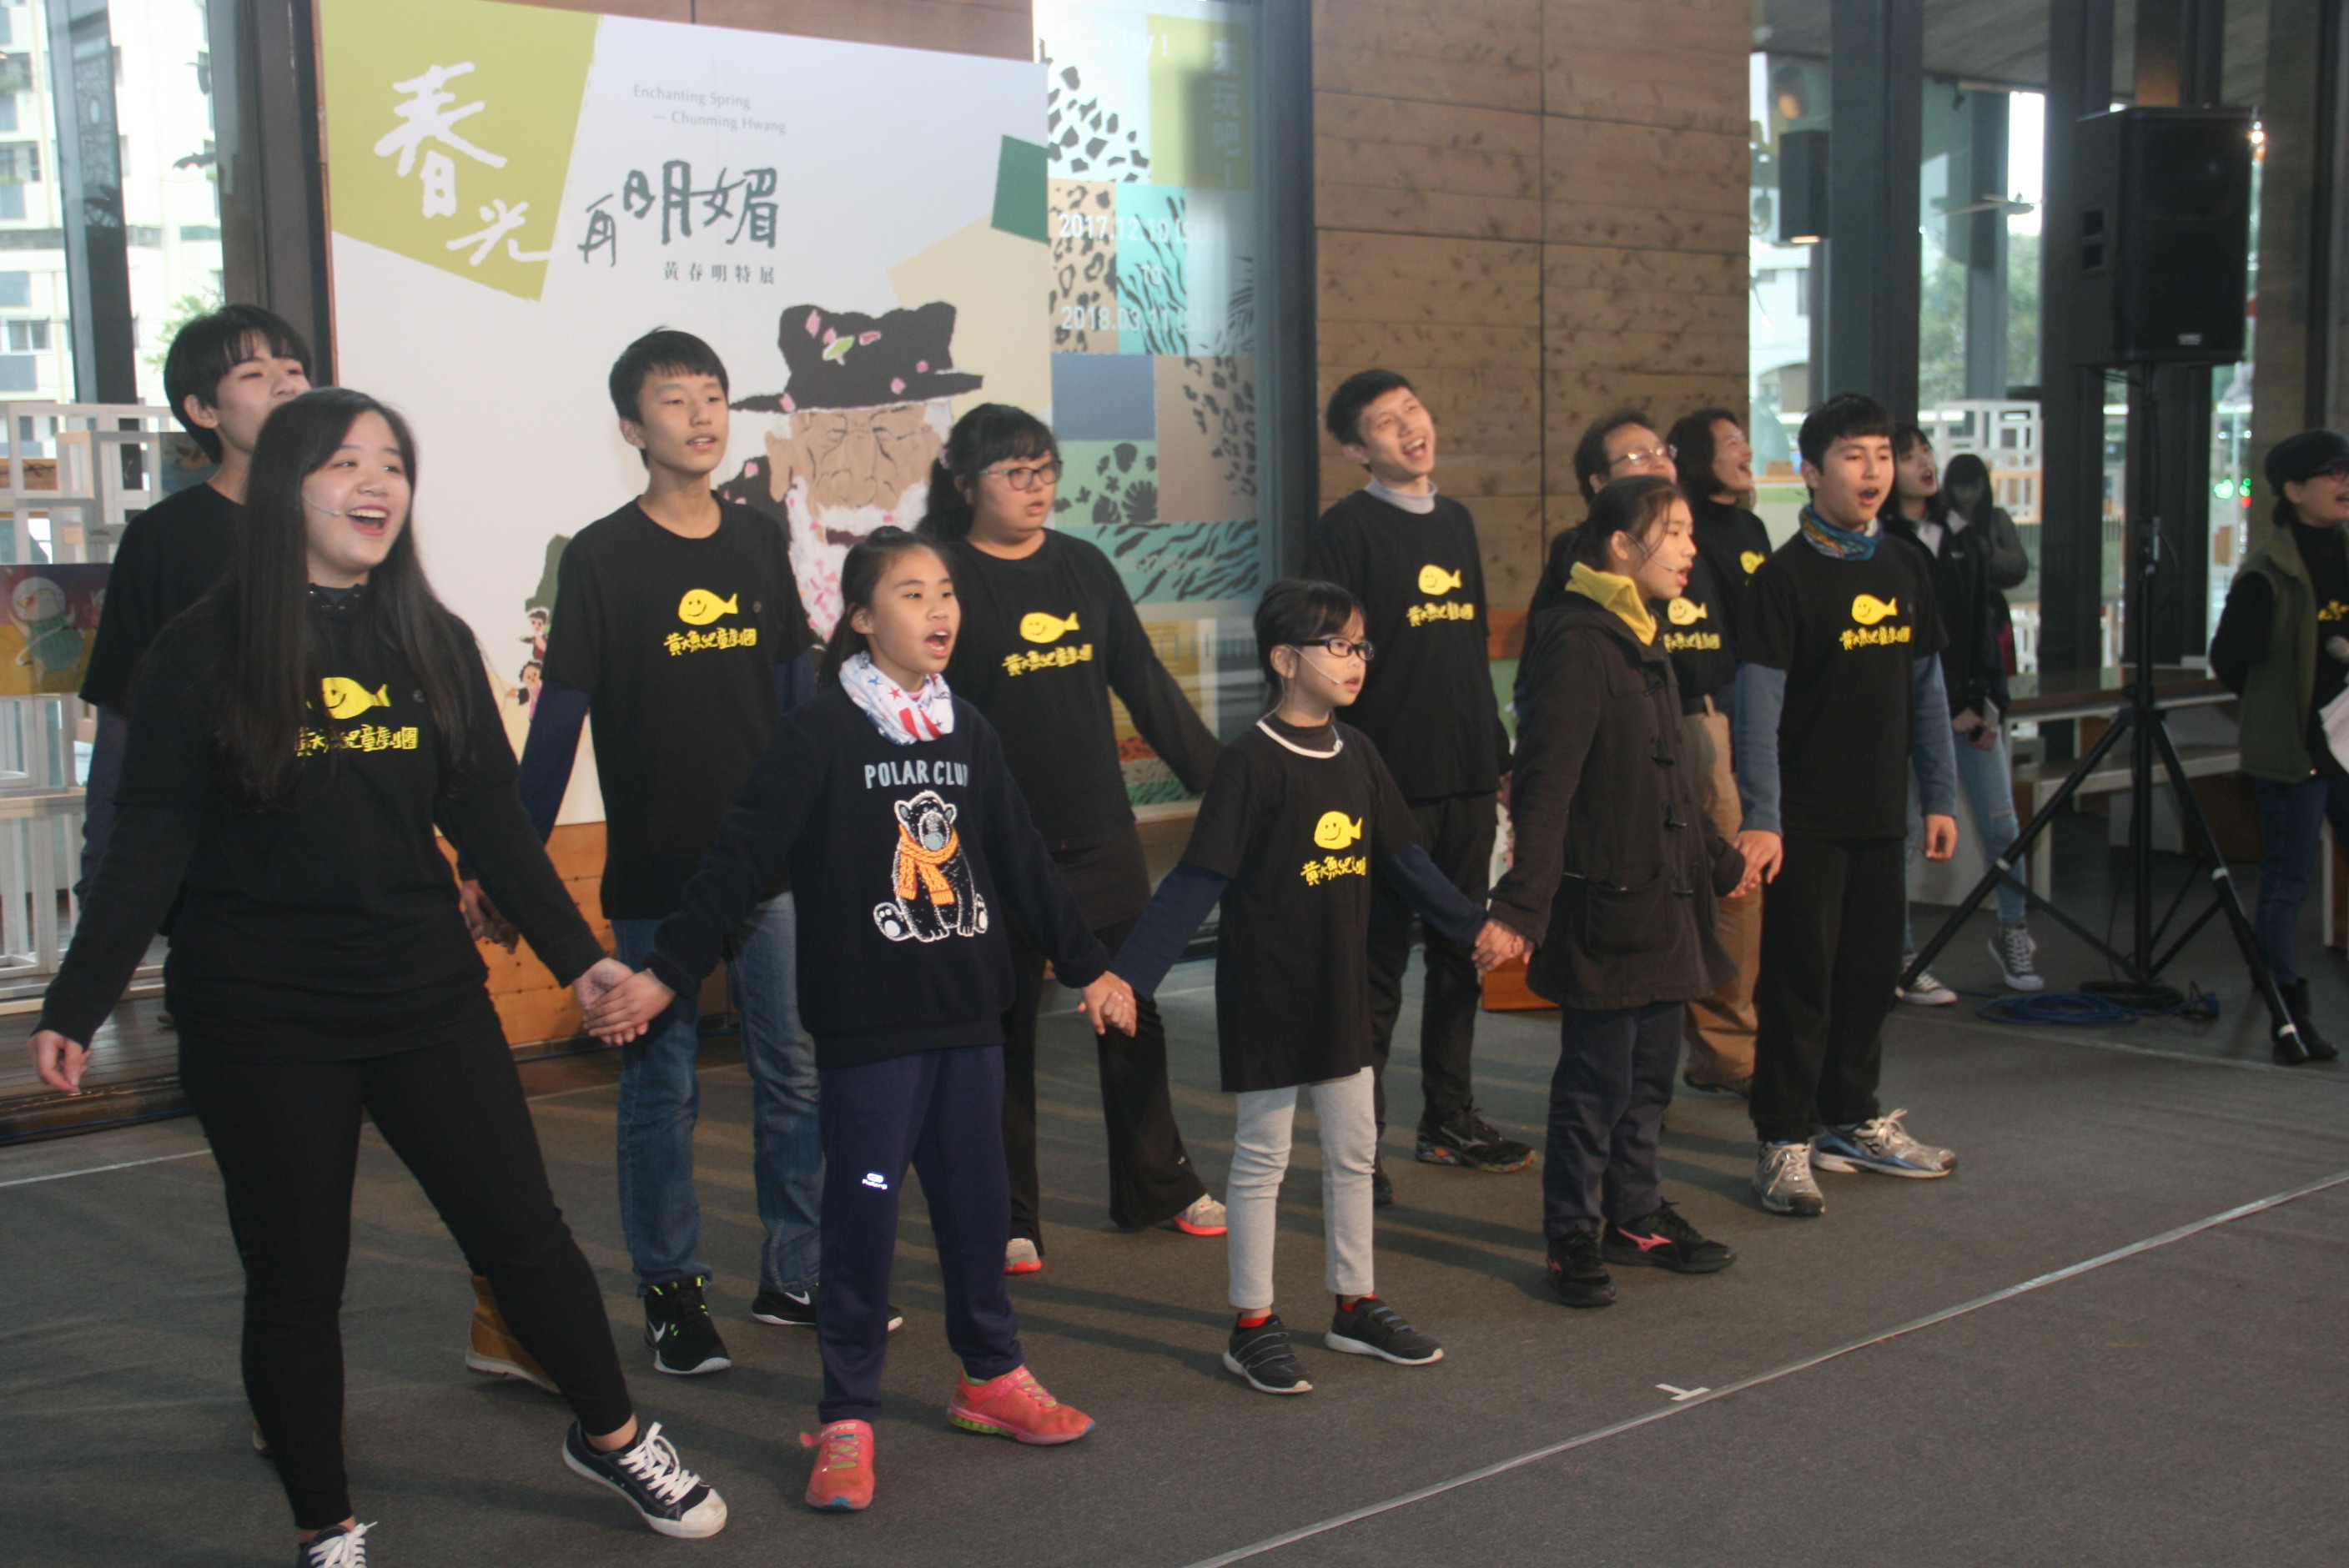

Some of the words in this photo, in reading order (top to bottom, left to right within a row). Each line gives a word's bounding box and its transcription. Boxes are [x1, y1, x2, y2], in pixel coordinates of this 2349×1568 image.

[633, 84, 707, 107] Enchanting
[710, 92, 751, 110] Spring
[672, 109, 738, 133] Chunming
[742, 116, 787, 136] Hwang
[374, 61, 551, 266] 春光
[664, 261, 776, 285] 黃春明特展
[864, 759, 930, 789] POLAR
